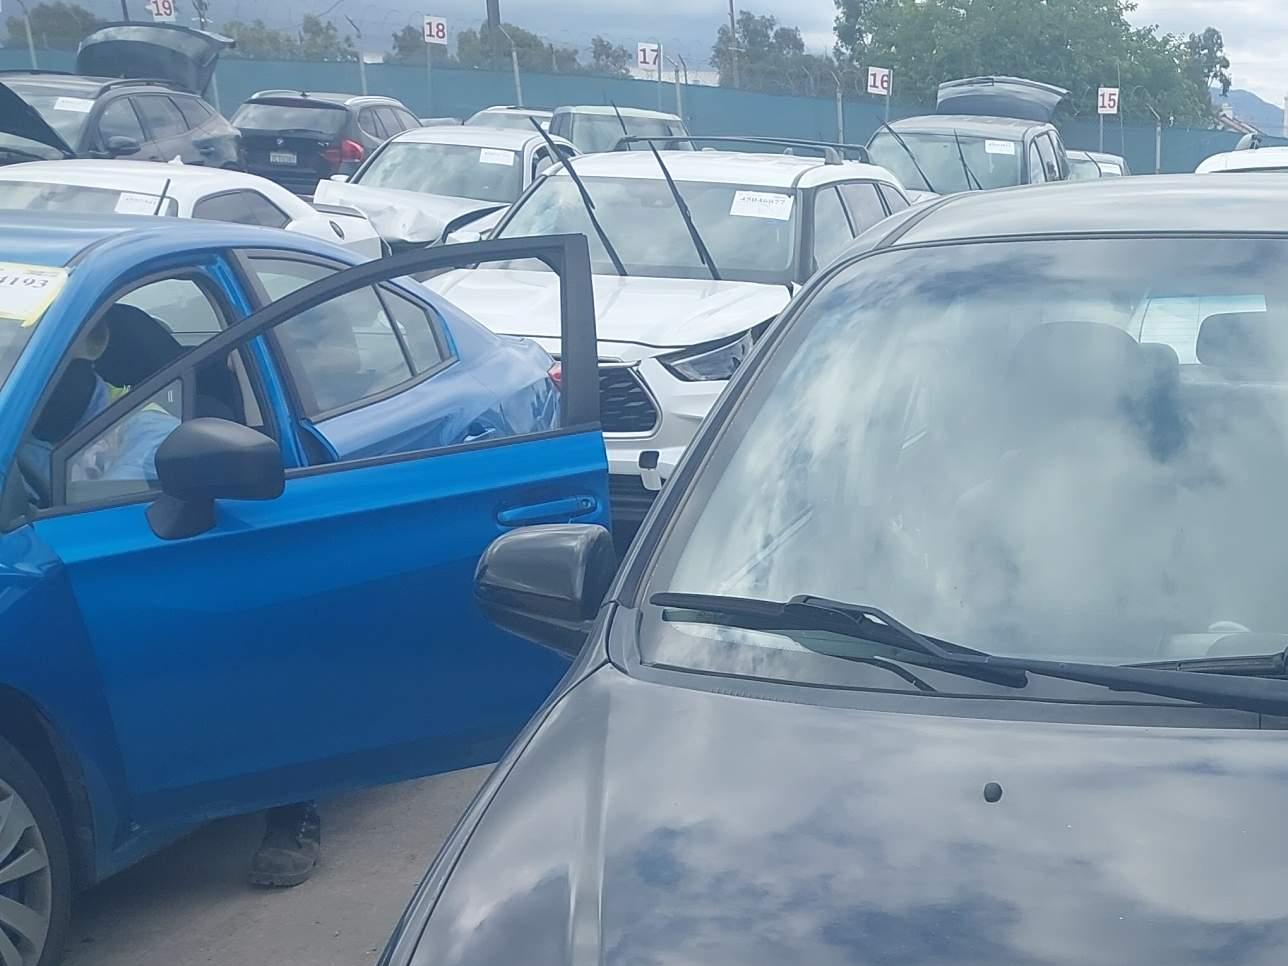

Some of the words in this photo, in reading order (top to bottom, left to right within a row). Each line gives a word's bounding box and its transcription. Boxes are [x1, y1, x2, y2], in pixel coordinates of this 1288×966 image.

[151, 0, 173, 17] 19
[425, 21, 447, 39] 18
[639, 47, 659, 67] 17
[869, 72, 890, 91] 16
[1099, 92, 1117, 109] 15
